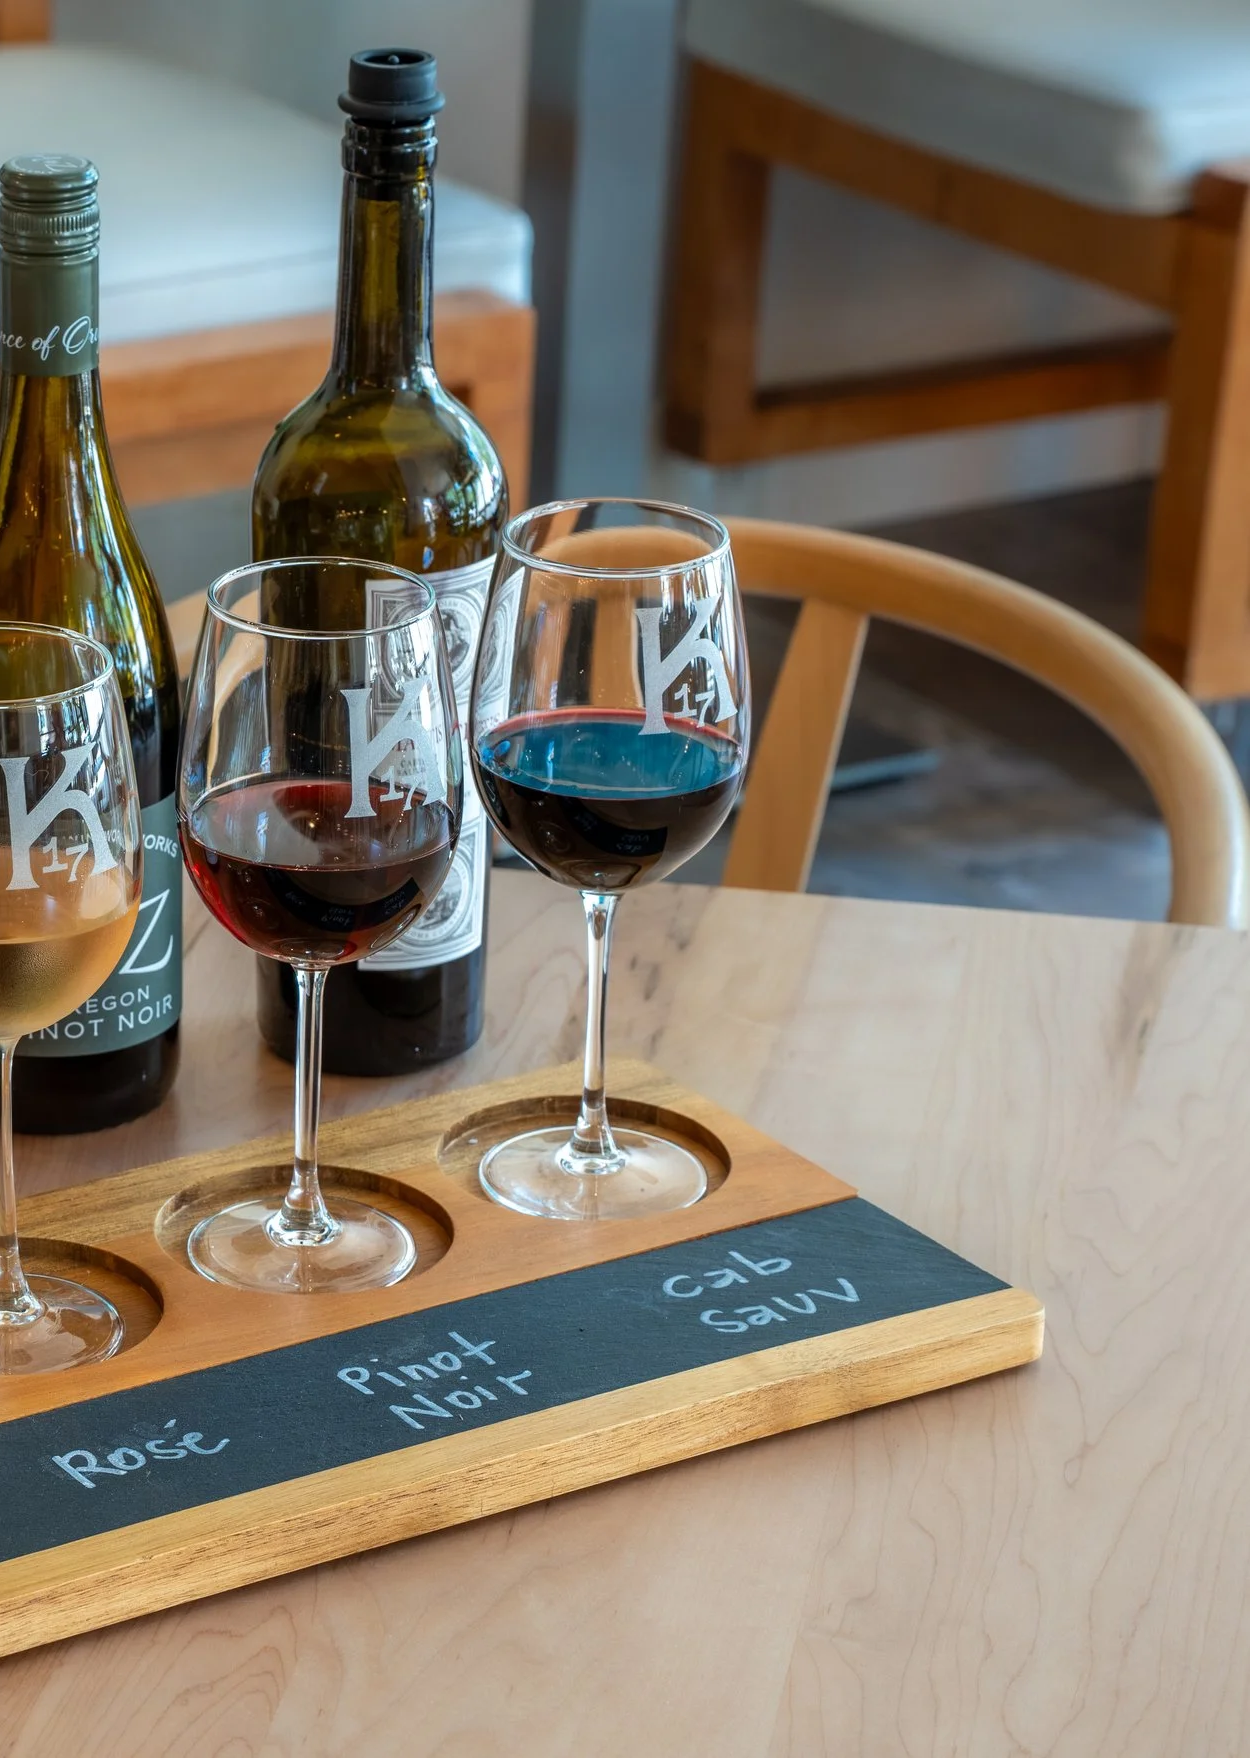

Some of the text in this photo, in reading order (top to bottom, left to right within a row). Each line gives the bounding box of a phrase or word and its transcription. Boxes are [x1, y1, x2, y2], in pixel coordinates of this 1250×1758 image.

[31, 325, 55, 361] of
[635, 592, 738, 735] K
[674, 682, 715, 728] 17
[339, 674, 447, 819] K
[379, 764, 425, 811] 17
[42, 836, 89, 883] 17
[143, 834, 179, 858] ORKS
[118, 994, 173, 1032] NOIR
[336, 1331, 496, 1396] Pinot
[388, 1369, 533, 1431] Noir
[52, 1419, 230, 1489] Rosé
